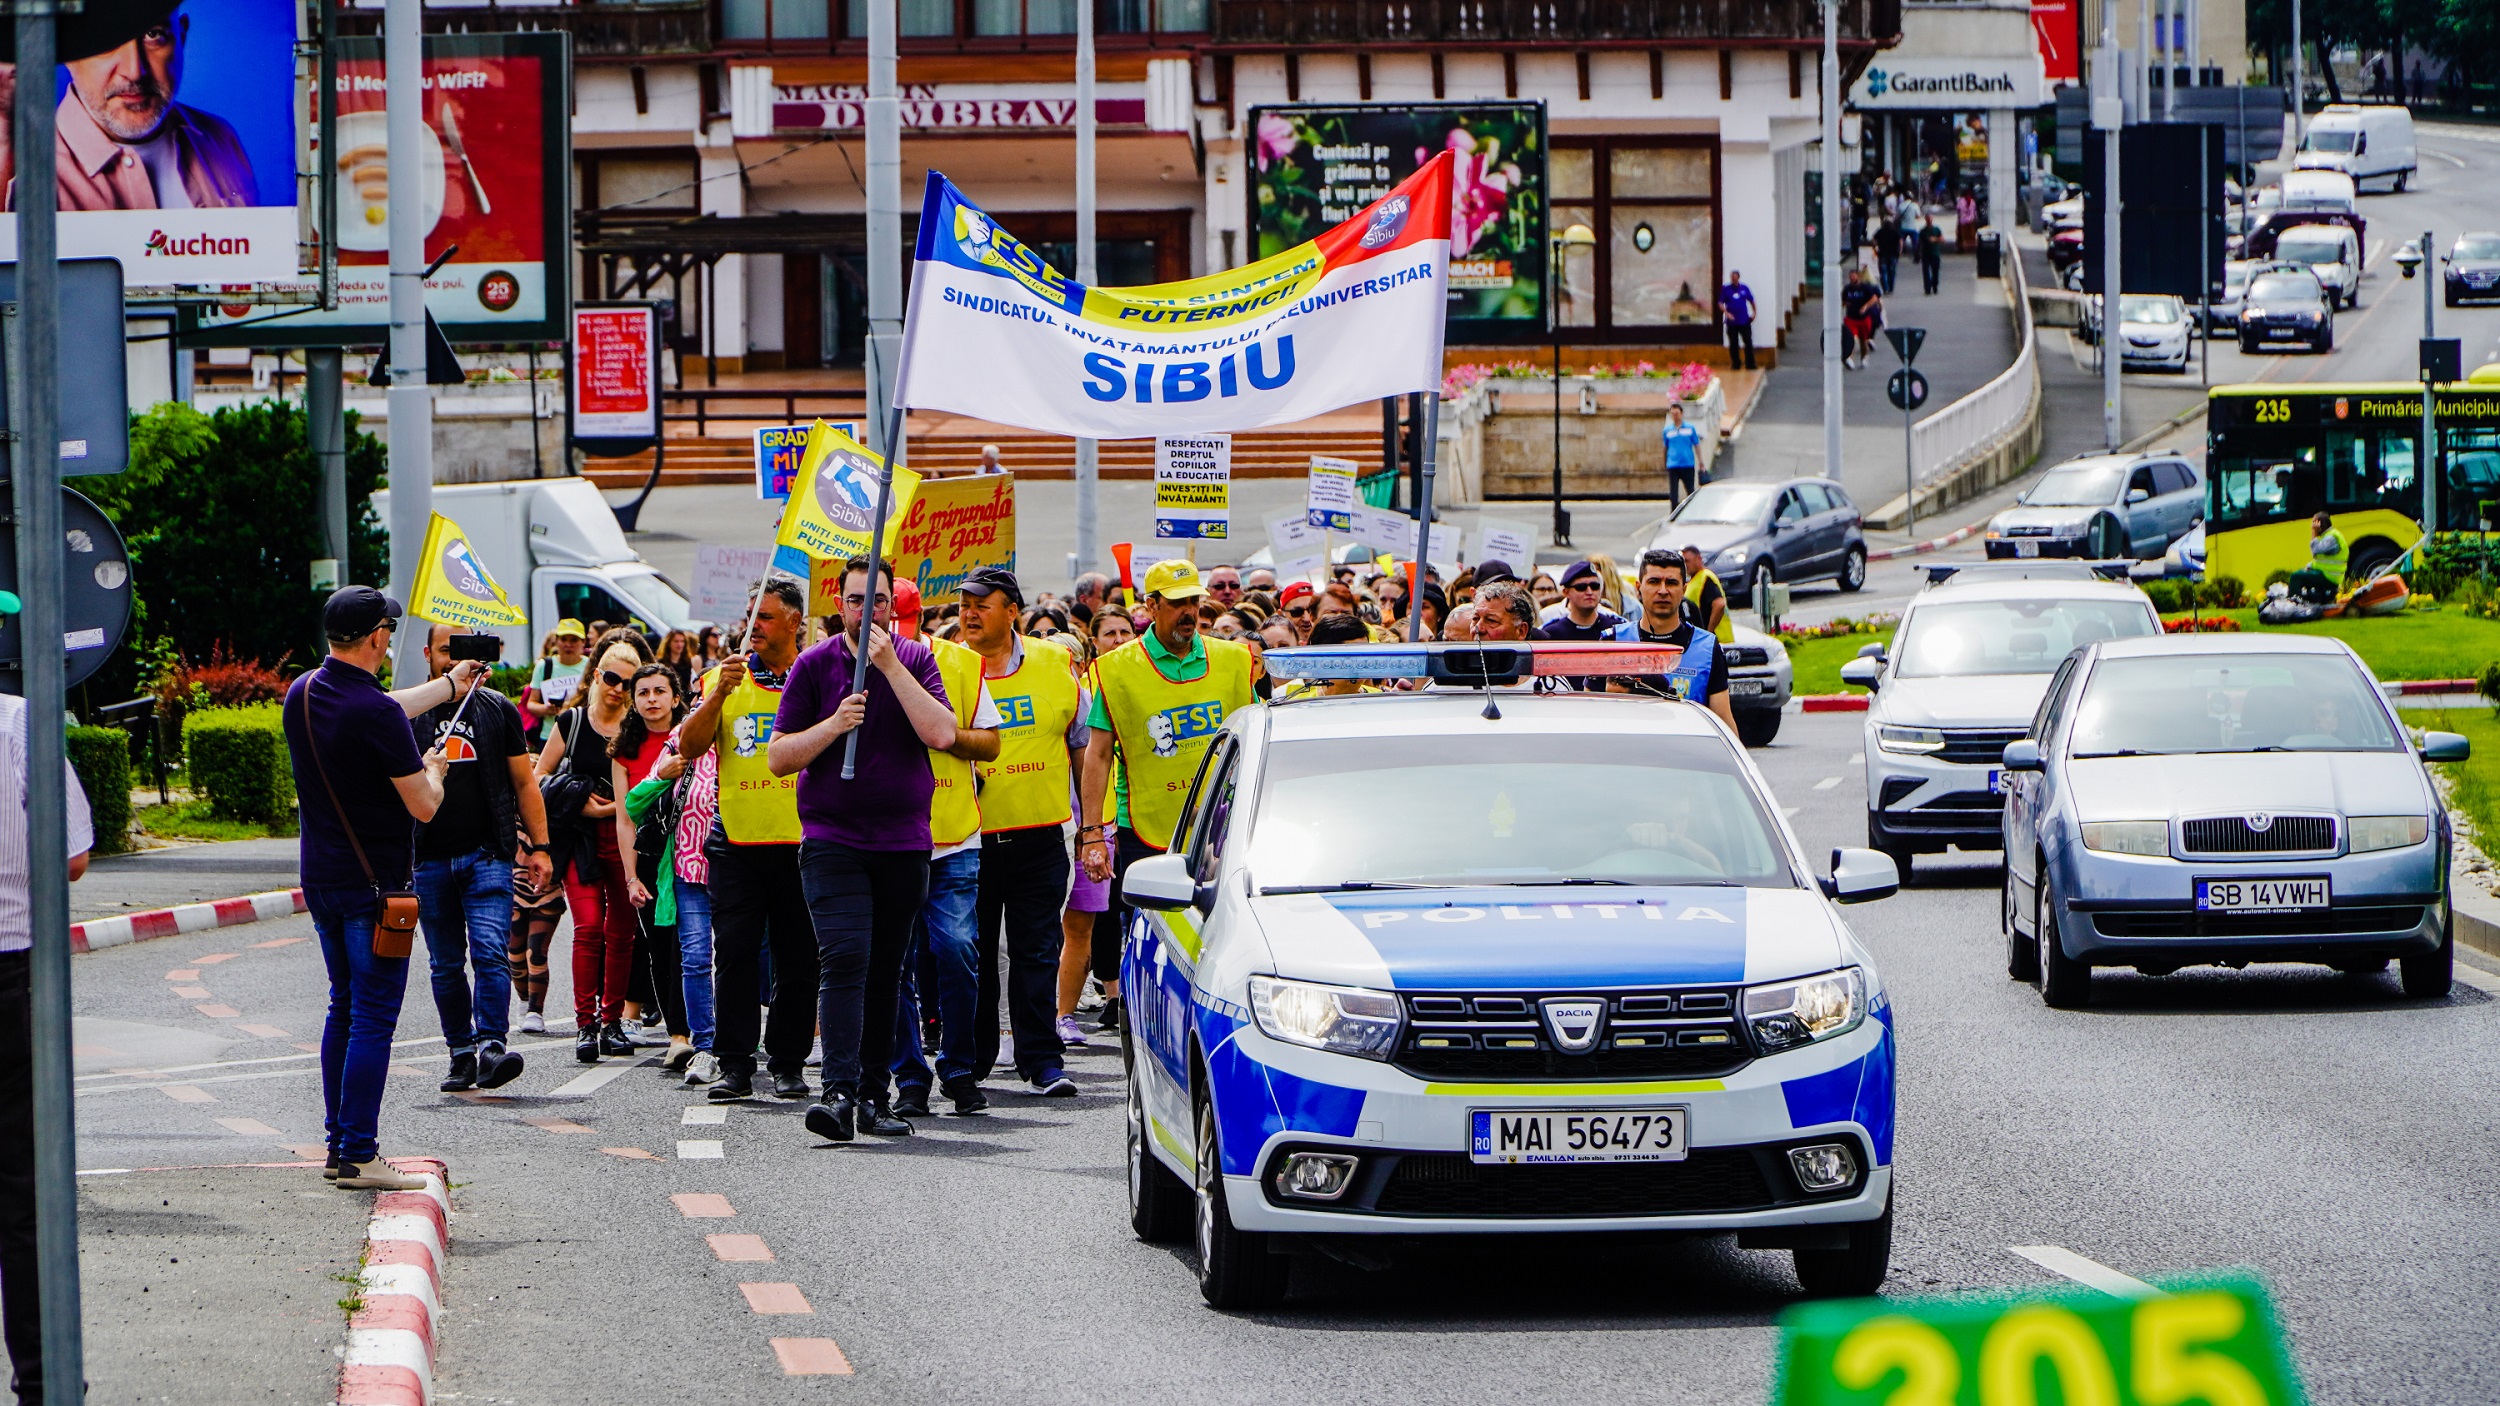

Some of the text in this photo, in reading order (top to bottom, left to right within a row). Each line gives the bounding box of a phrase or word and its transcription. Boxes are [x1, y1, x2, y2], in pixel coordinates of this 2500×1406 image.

[438, 72, 488, 89] WiFi?
[1892, 71, 2015, 92] GarantiBank
[778, 84, 937, 100] MAGAIN
[821, 100, 1099, 127] DMBRAV
[144, 229, 250, 256] Auchan
[1365, 229, 1396, 246] Sibiu
[991, 227, 1066, 290] FSE
[366, 294, 388, 304] sun
[487, 281, 510, 296] 25
[1024, 275, 1063, 301] Haret
[943, 286, 1058, 326] SINDICATUL
[1118, 281, 1300, 323] PUTERNICI!
[1082, 333, 1296, 403] SIBIU
[2255, 399, 2291, 423] 235
[2361, 399, 2424, 417] Primăria
[1164, 440, 1224, 451] RESPECTAȚI
[1170, 450, 1215, 459] DREPTUL
[850, 455, 880, 477] SIP
[1160, 471, 1173, 479] LA
[1171, 461, 1217, 470] COPIILOR
[1161, 483, 1223, 494] INVESTIȚI ÎN
[830, 503, 867, 529] Sibiu
[1207, 522, 1227, 532] FSE
[797, 531, 854, 560] PUTERN
[801, 519, 871, 553] UNIȚI SUNTE
[459, 576, 493, 599] Sibi
[432, 595, 515, 623] UNIȚI SUNTEM
[996, 698, 1034, 724] SE
[1171, 704, 1221, 735] FSE
[1006, 761, 1046, 774] SIBIU
[740, 780, 775, 791] S.I.P.
[934, 778, 953, 788] BIU
[2198, 897, 2208, 907] RO
[2210, 884, 2242, 906] SB
[1556, 1009, 1593, 1017] DACIA
[1475, 1115, 1673, 1151] RO MAI 56473
